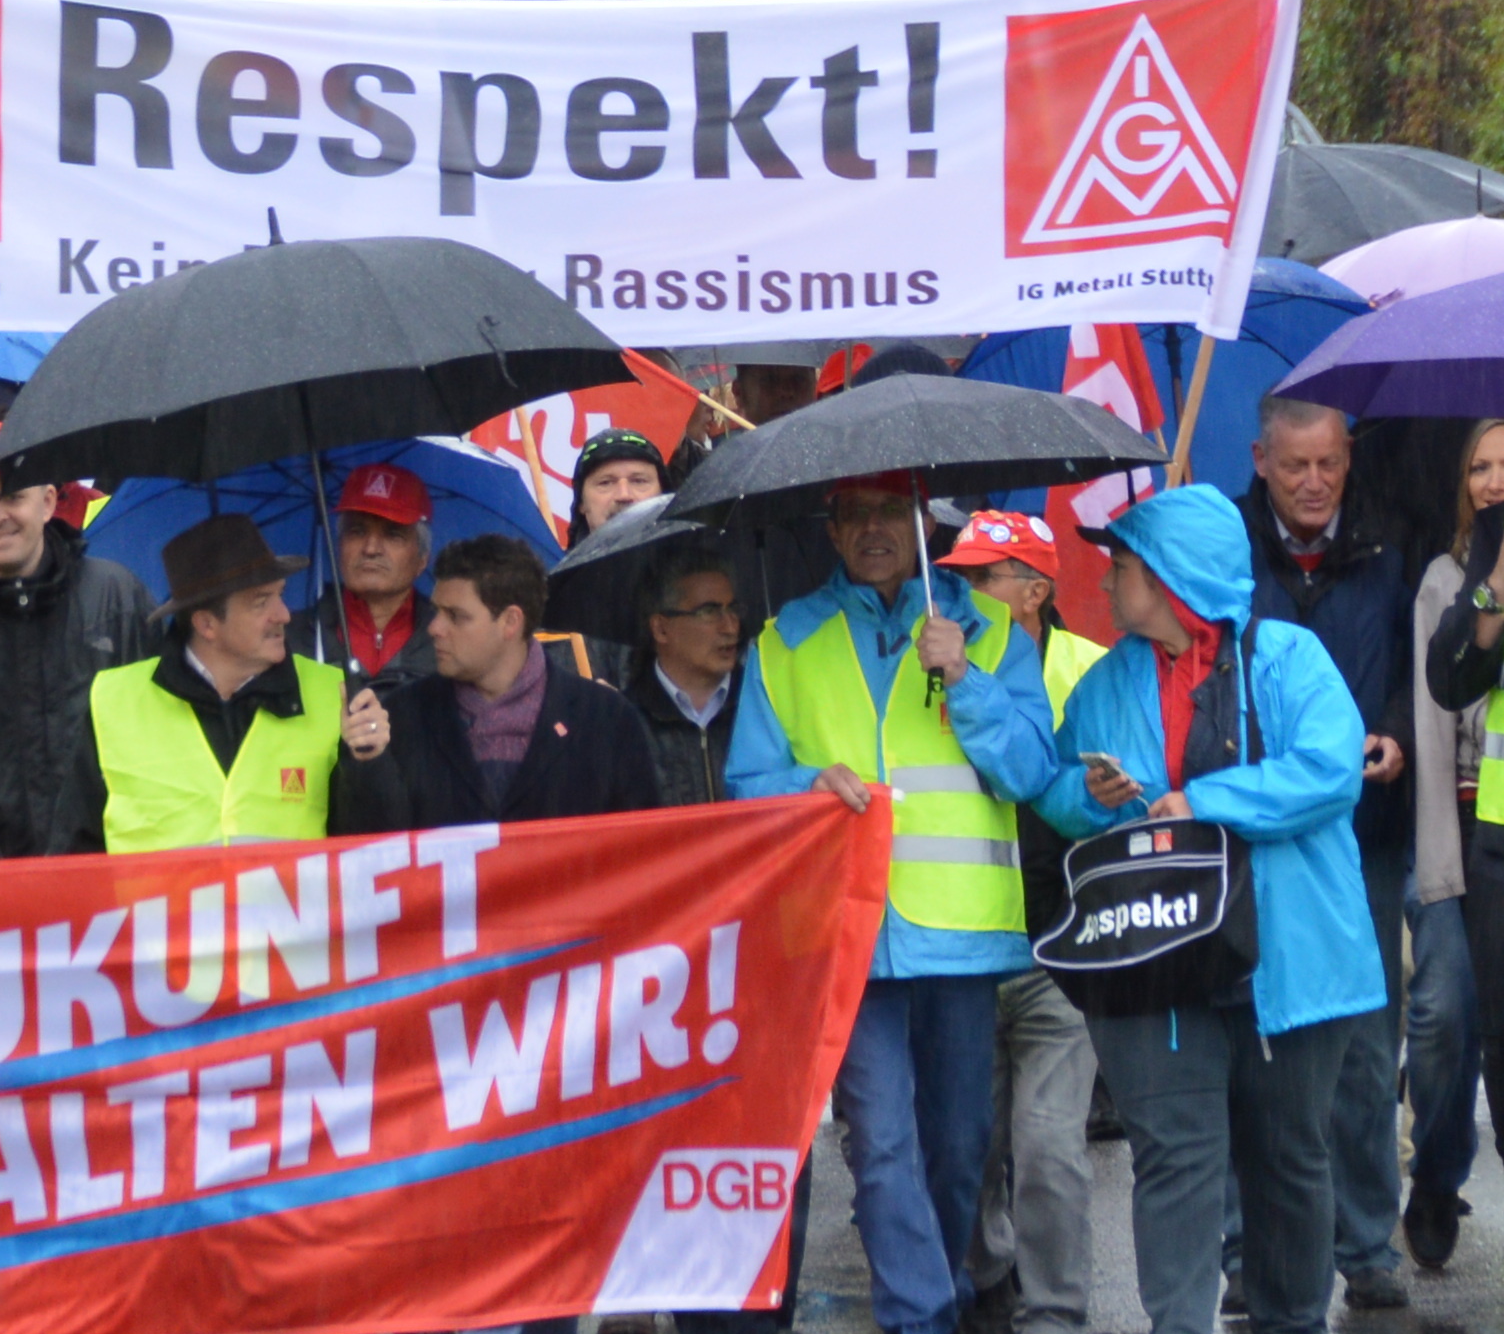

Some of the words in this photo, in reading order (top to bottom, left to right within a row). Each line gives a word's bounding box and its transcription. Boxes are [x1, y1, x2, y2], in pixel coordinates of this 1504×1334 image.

[563, 253, 942, 316] Rassismus
[1017, 281, 1044, 302] IG
[1052, 273, 1134, 299] Metall
[428, 919, 742, 1133] WIR!
[662, 1159, 790, 1213] DGB
